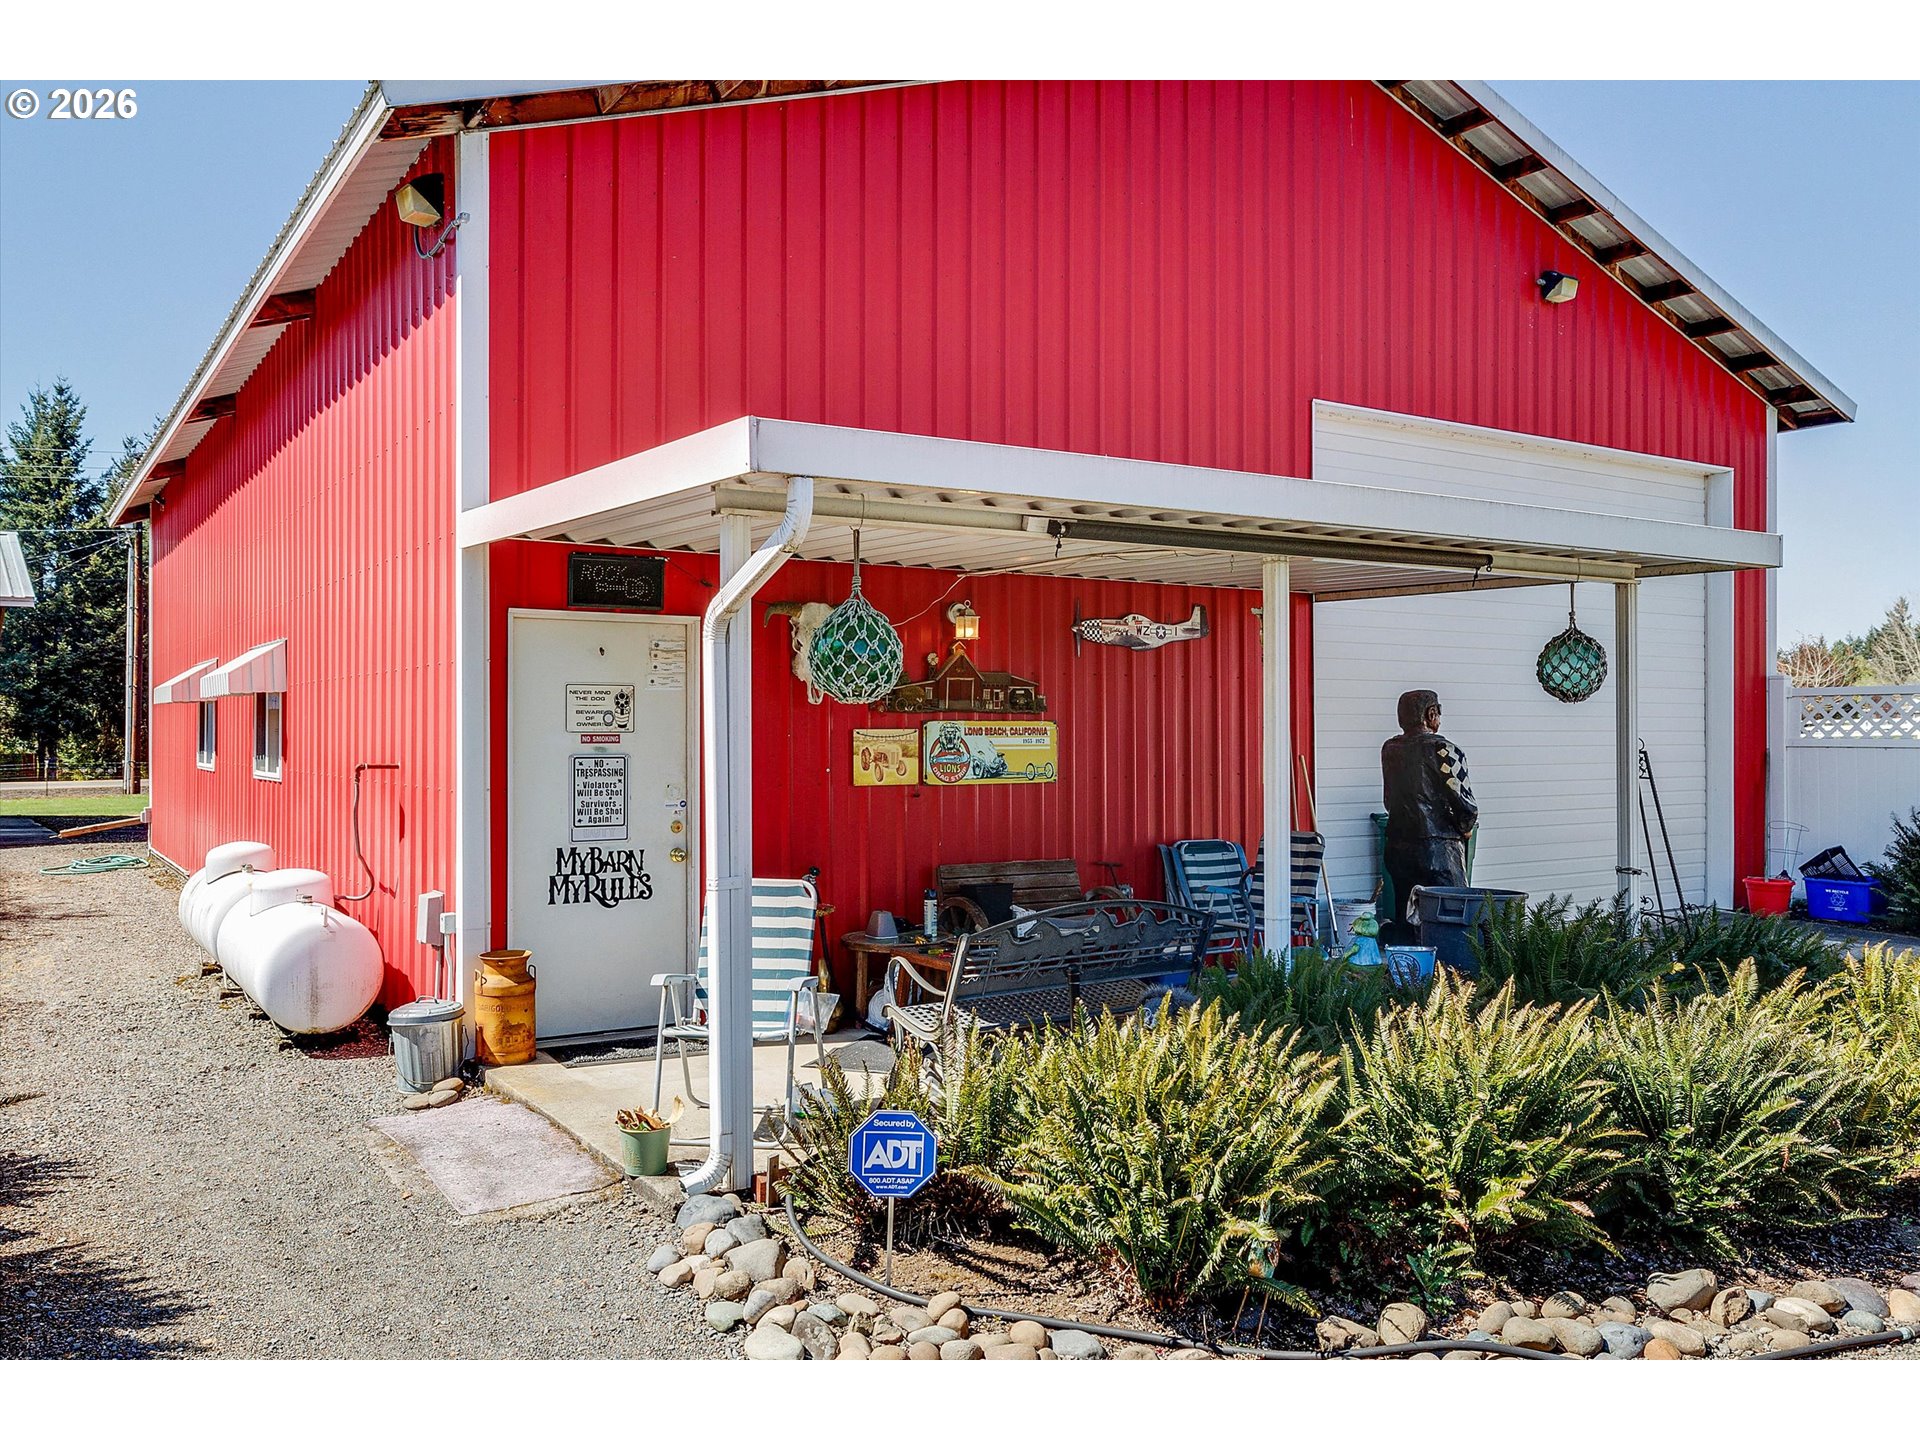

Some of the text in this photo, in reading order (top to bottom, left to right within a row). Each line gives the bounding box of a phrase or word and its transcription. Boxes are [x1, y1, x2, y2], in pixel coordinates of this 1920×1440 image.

[581, 565, 628, 582] ROCK
[1136, 625, 1150, 636] WZ
[964, 727, 1048, 737] LONG BEACH, CALIFORNIA
[594, 760, 604, 768] NO
[940, 764, 961, 773] LIONS
[576, 768, 624, 777] TRESPASSING
[933, 766, 967, 781] DRAG STRIP
[582, 781, 617, 789] Violators
[577, 789, 622, 797] Will Be Shot
[580, 800, 617, 808] Survivors
[577, 808, 592, 816] Will
[594, 808, 603, 816] Be
[588, 815, 612, 824] Again!
[873, 1119, 917, 1129] Secured by
[864, 1139, 922, 1170] ADT
